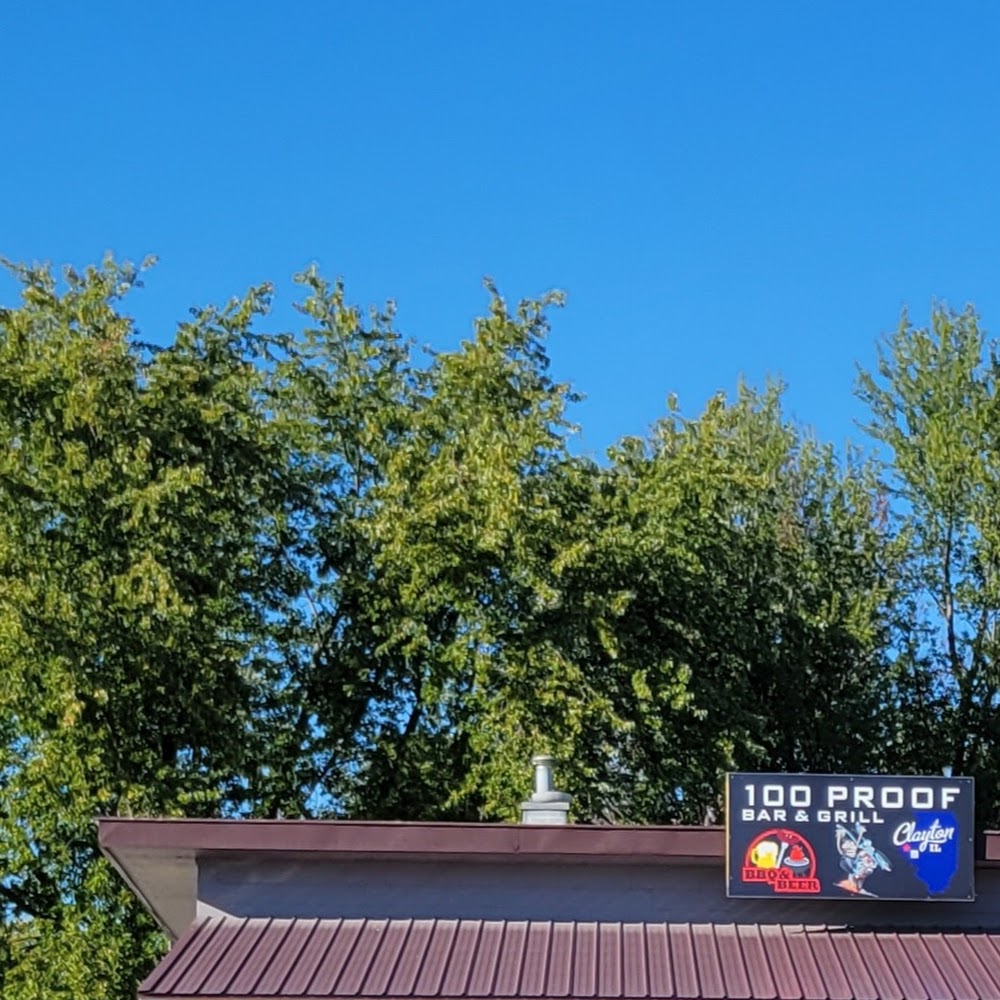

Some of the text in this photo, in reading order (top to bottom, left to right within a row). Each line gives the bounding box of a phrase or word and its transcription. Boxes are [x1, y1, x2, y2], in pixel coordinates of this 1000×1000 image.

[745, 784, 960, 809] 100 PROOF
[742, 809, 884, 824] BAR & GRILL
[893, 818, 954, 852] Clayton
[929, 844, 941, 853] IL
[745, 869, 777, 881] BBQ
[777, 880, 819, 890] BEER
